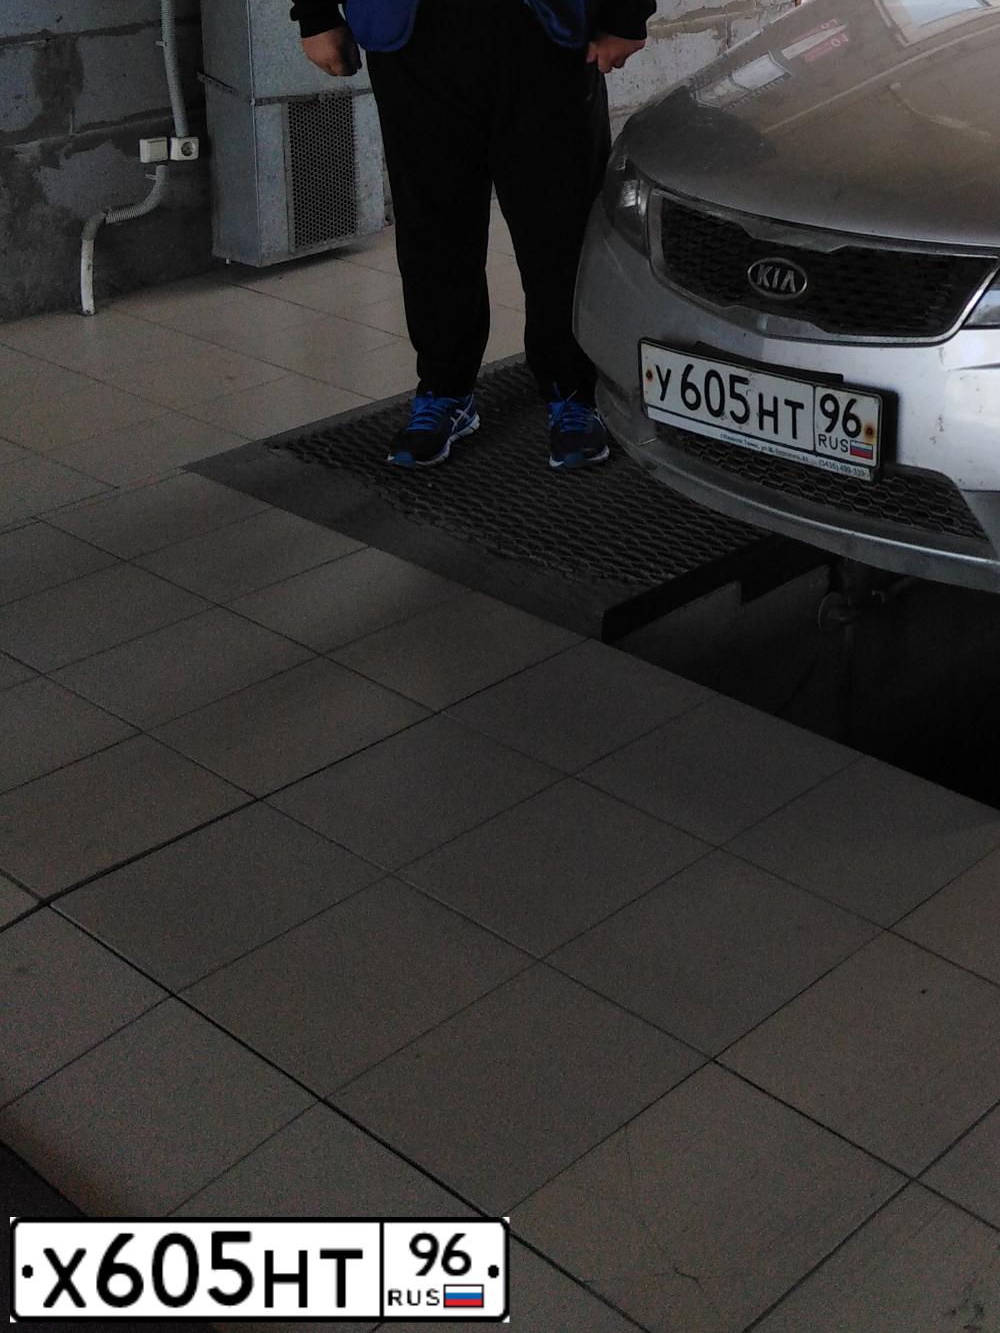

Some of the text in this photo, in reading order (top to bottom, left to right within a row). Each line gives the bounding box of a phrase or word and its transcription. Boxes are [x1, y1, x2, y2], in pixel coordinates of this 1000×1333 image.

[756, 265, 797, 293] KIA
[819, 392, 862, 439] 96
[818, 433, 849, 453] RUS
